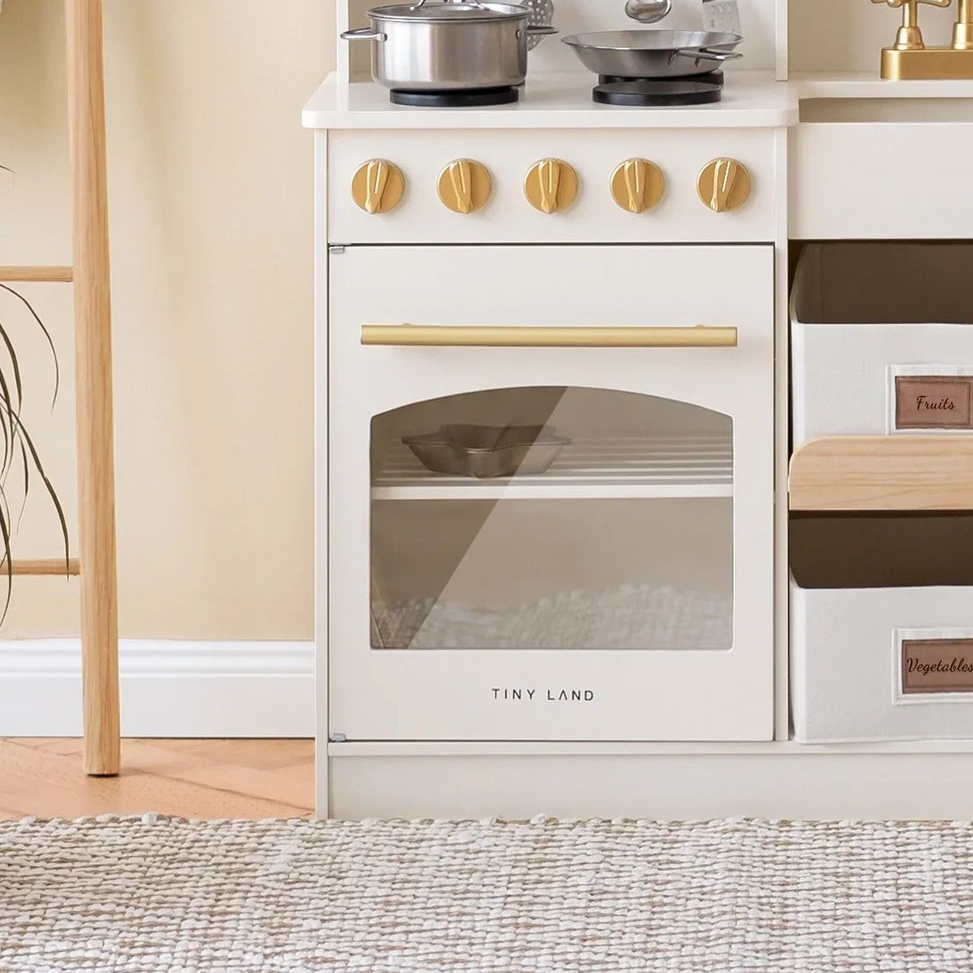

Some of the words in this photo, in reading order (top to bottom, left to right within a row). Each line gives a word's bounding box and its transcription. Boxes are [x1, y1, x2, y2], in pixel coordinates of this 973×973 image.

[916, 395, 956, 411] Fruits
[491, 688, 535, 700] TINY
[547, 689, 594, 701] LAND
